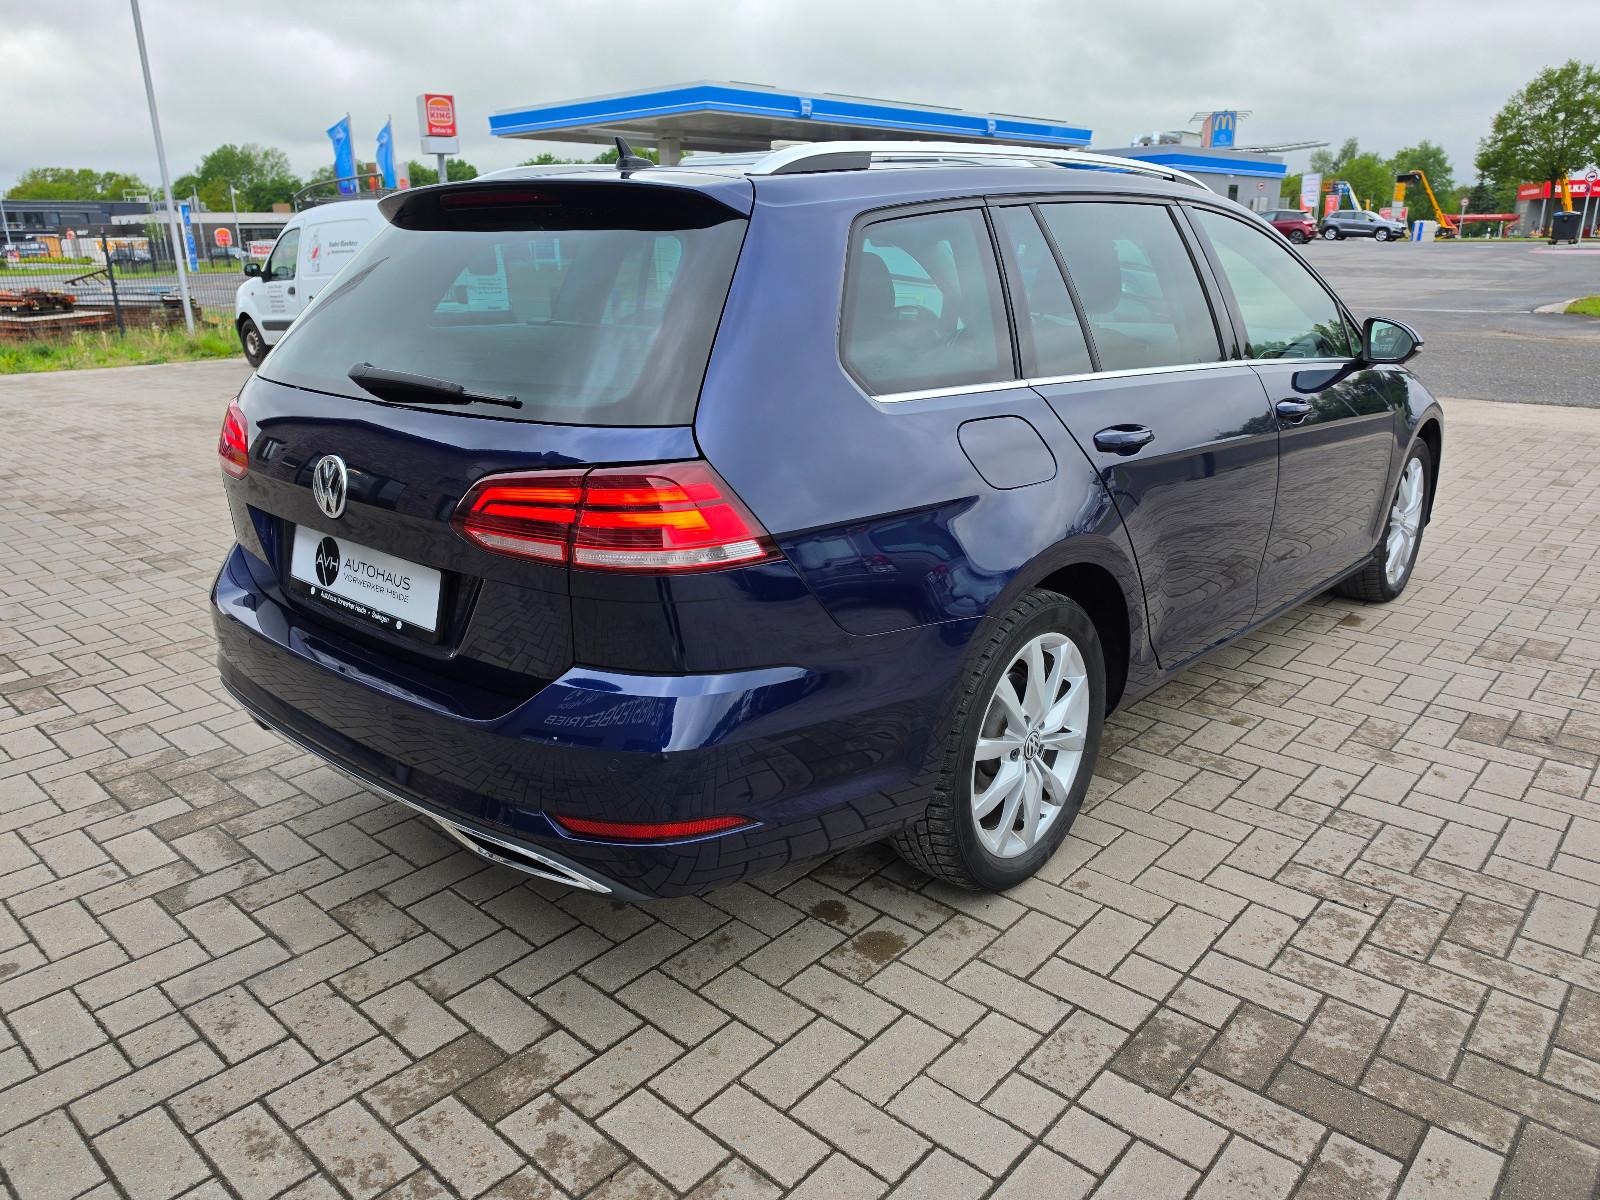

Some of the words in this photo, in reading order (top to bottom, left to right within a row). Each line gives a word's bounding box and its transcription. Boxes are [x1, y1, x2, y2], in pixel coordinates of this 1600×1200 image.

[316, 553, 339, 572] AVH
[343, 572, 385, 594] VORWERKER
[344, 558, 411, 591] AUTOHAUS
[385, 588, 409, 604] HEIDE
